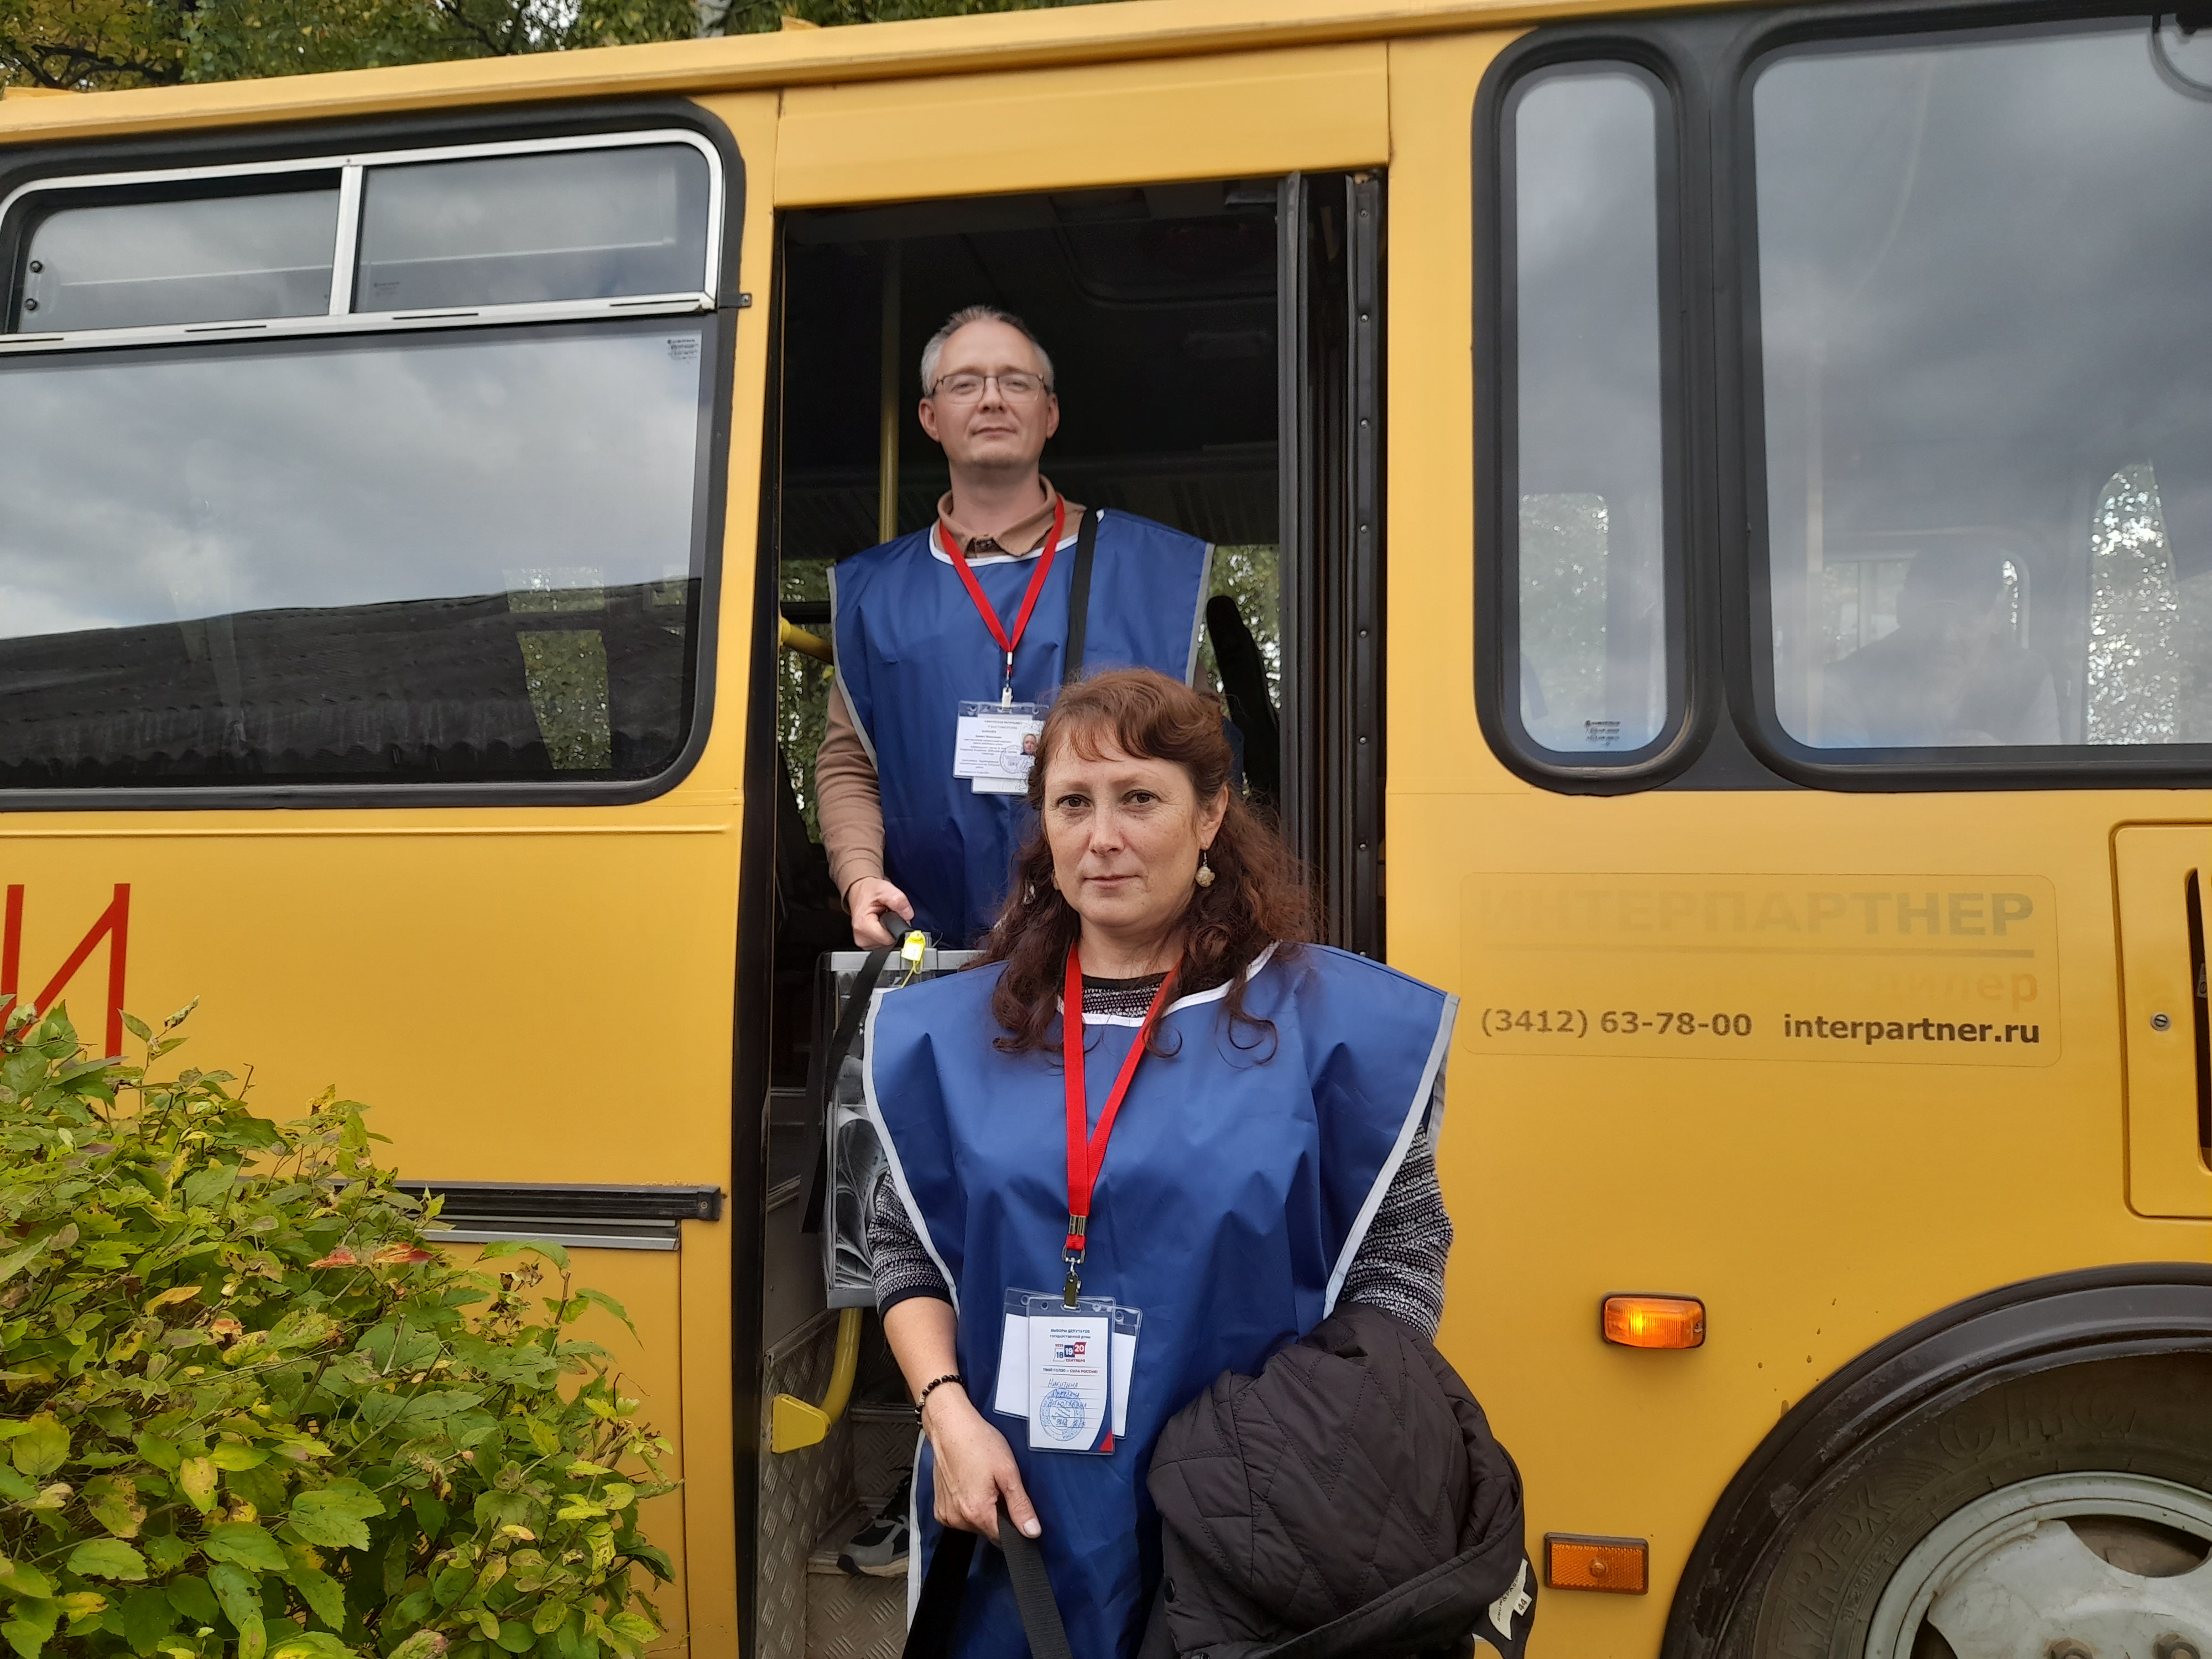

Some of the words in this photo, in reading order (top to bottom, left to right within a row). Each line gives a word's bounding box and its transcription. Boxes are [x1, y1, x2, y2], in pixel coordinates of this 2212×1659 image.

[1480, 888, 2034, 936] ИНТЕРПАРТНЕР
[1481, 1008, 1588, 1038] (3412)
[1600, 1010, 1752, 1037] 63-78-00
[1784, 1013, 2039, 1045] interpartner.ru
[1065, 1347, 1073, 1355] 19
[1074, 1344, 1084, 1353] 20
[1518, 1598, 1527, 1611] 44
